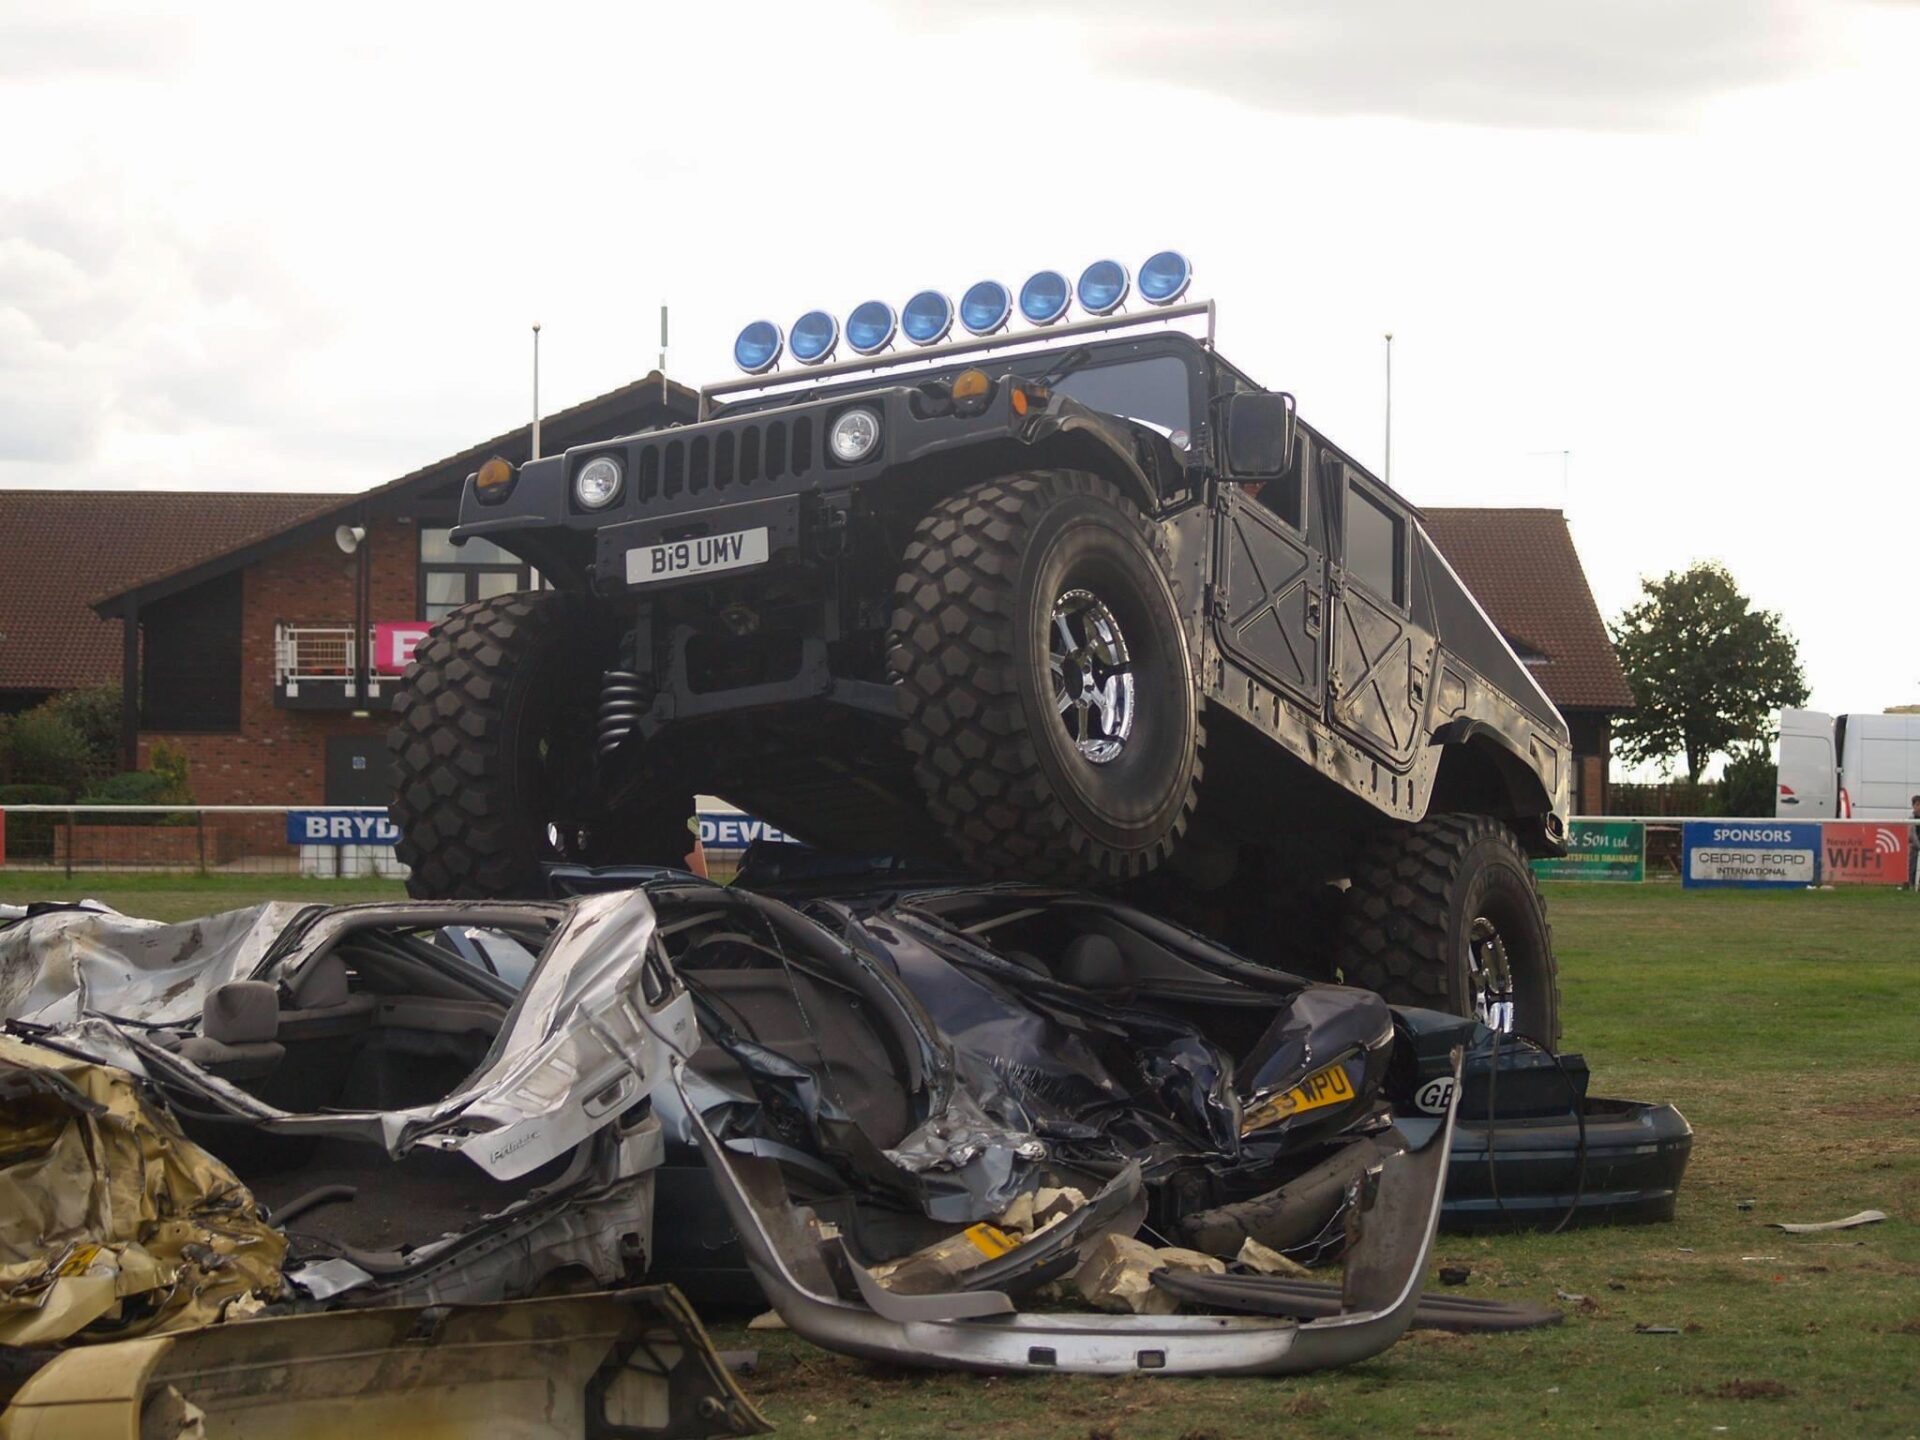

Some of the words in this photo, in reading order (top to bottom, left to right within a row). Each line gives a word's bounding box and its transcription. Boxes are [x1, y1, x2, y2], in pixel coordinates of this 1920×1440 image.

[697, 534, 744, 566] UMV
[1582, 832, 1609, 848] Son
[1713, 829, 1792, 842] SPONSORS
[1699, 852, 1756, 864] CEDRIC
[1762, 854, 1806, 865] FORD
[1827, 847, 1883, 869] WiFi
[1716, 867, 1787, 876] INTERNATIONAL
